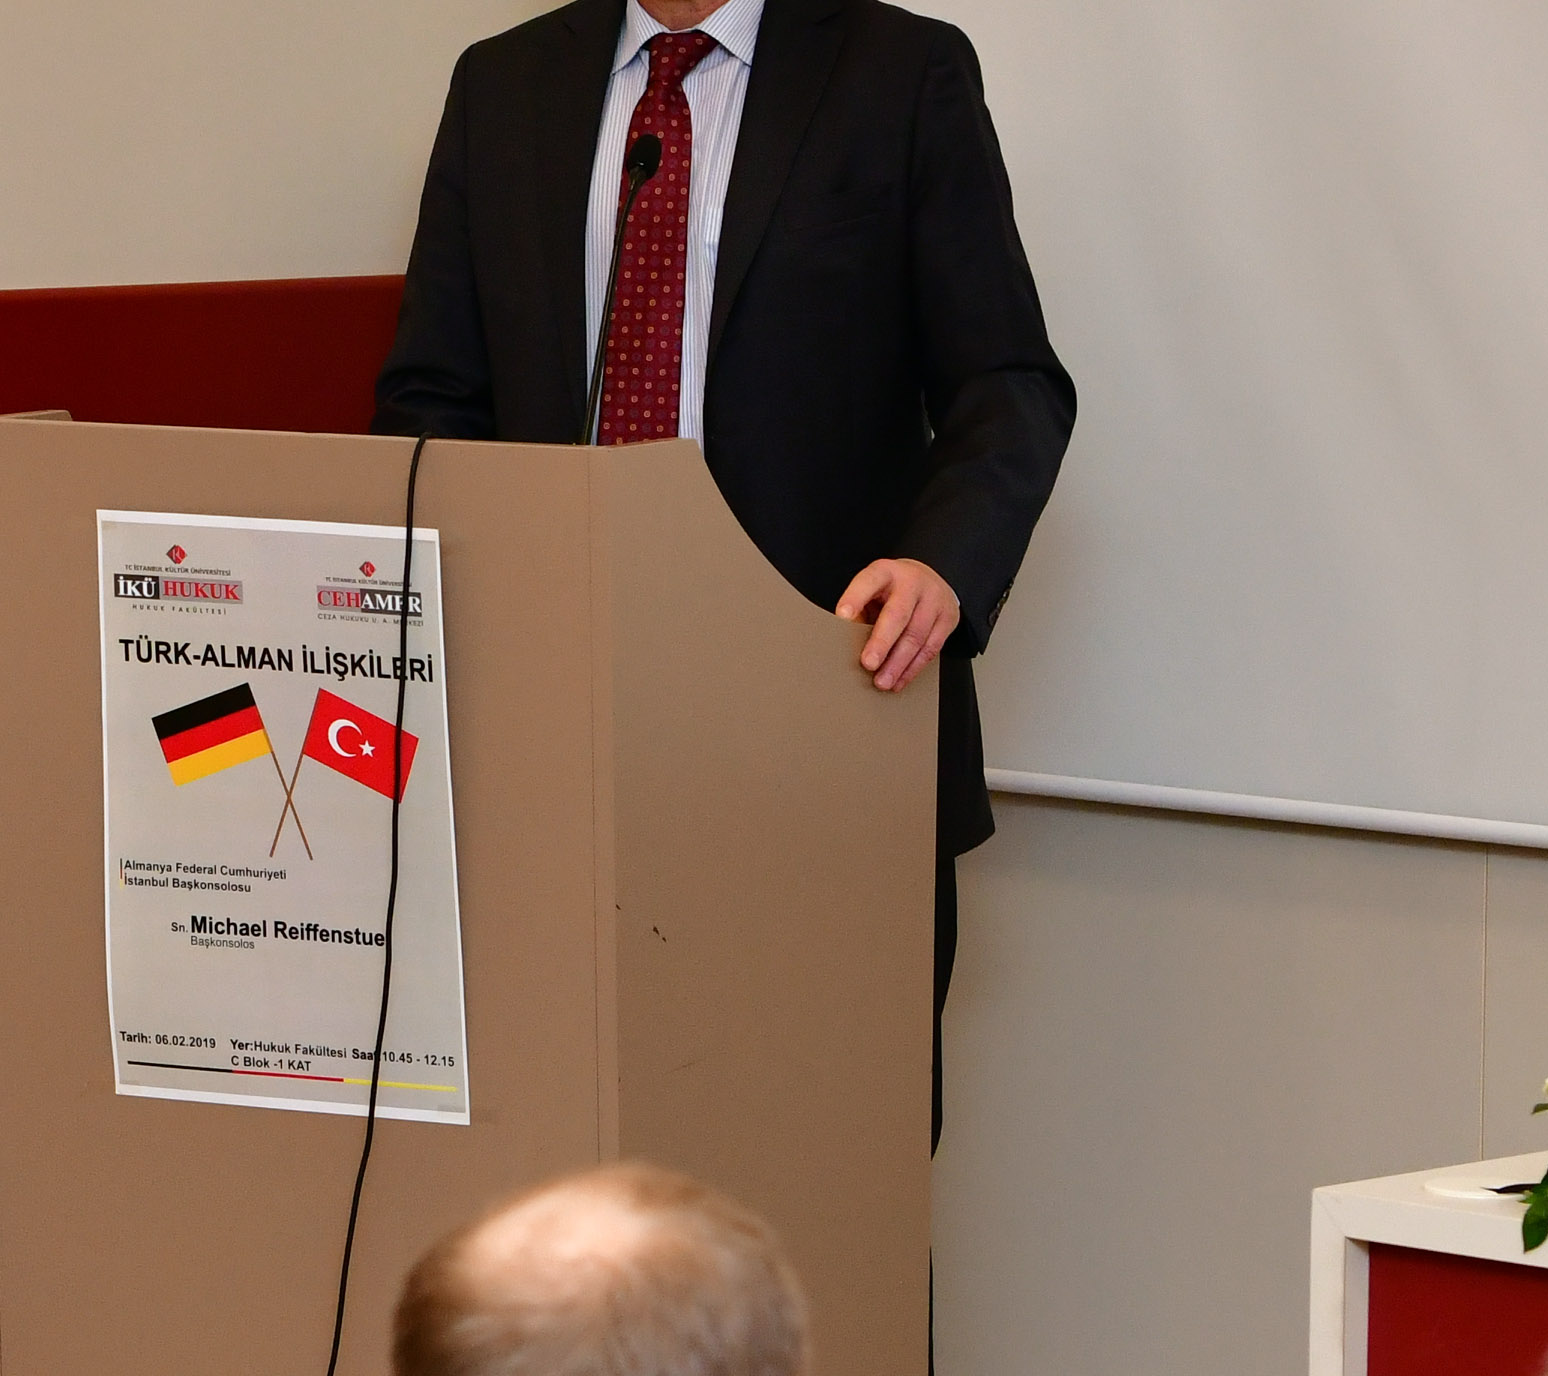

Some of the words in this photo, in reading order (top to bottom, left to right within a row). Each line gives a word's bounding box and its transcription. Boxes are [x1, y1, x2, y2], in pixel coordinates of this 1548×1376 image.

[117, 576, 156, 598] İKÜ
[163, 580, 240, 601] HUKUK
[132, 604, 165, 612] HUKUK
[172, 605, 227, 615] FAKÜLTESİ
[339, 615, 369, 623] HUKUKU
[119, 635, 294, 672] TÜRK-ALMAN
[302, 644, 434, 682] İLİŞKİLERİ
[124, 859, 172, 874] Almanya
[176, 862, 217, 875] Federal
[220, 865, 287, 881] Cumhuriyeti
[124, 873, 169, 887] İstanbul
[172, 877, 251, 893] Başkonsolosu
[171, 922, 189, 933] Sn.
[191, 915, 267, 938] Michael
[274, 920, 386, 947] Reiffenstue
[190, 936, 255, 949] Başkonsolos
[119, 1031, 152, 1044] Tarih:
[155, 1034, 216, 1049] 06.02.2019
[294, 1044, 347, 1058] Fakültesi
[423, 1055, 455, 1067] 12.15
[231, 1055, 240, 1066] C
[244, 1056, 270, 1069] Blok
[274, 1058, 283, 1070] -1
[288, 1059, 311, 1072] KAT
